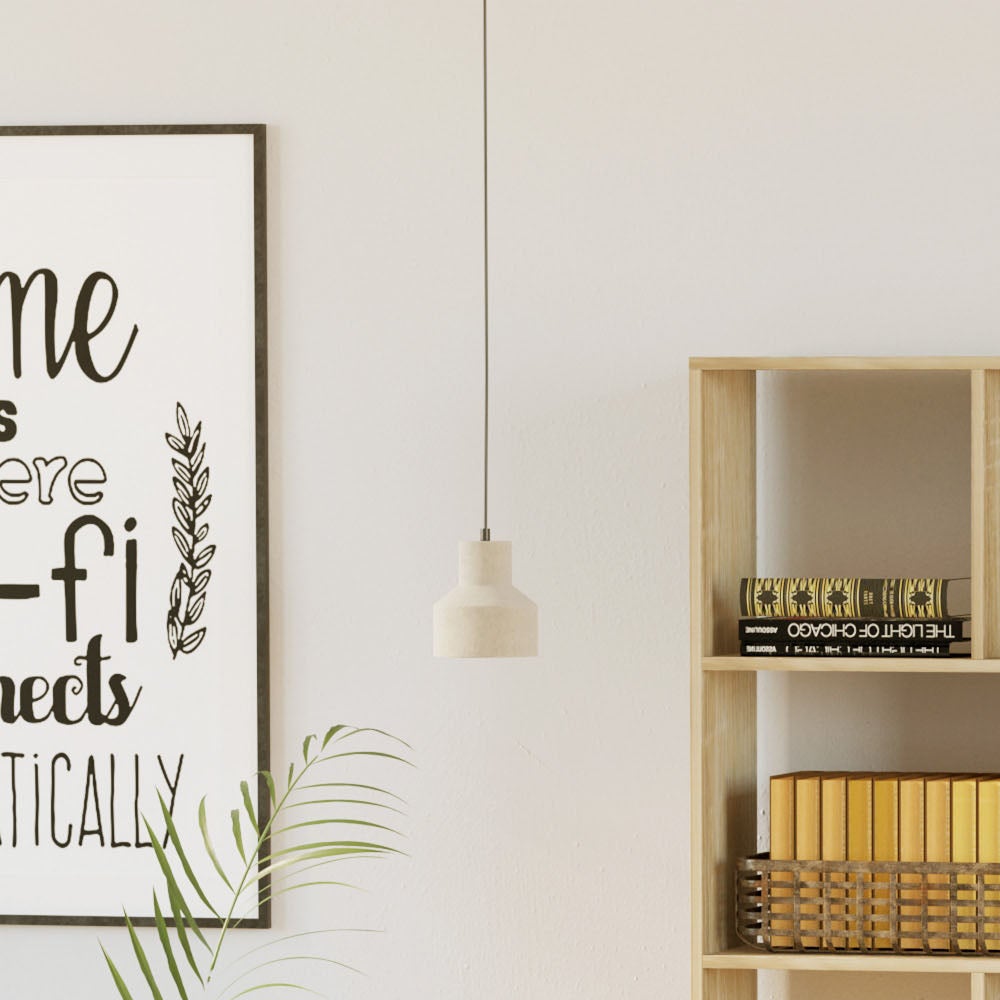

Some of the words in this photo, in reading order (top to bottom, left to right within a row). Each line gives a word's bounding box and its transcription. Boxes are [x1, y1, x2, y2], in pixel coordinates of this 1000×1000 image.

[787, 622, 857, 638] CHICAGO
[859, 623, 880, 638] OF
[881, 624, 924, 639] LIGHT
[926, 624, 956, 639] THE
